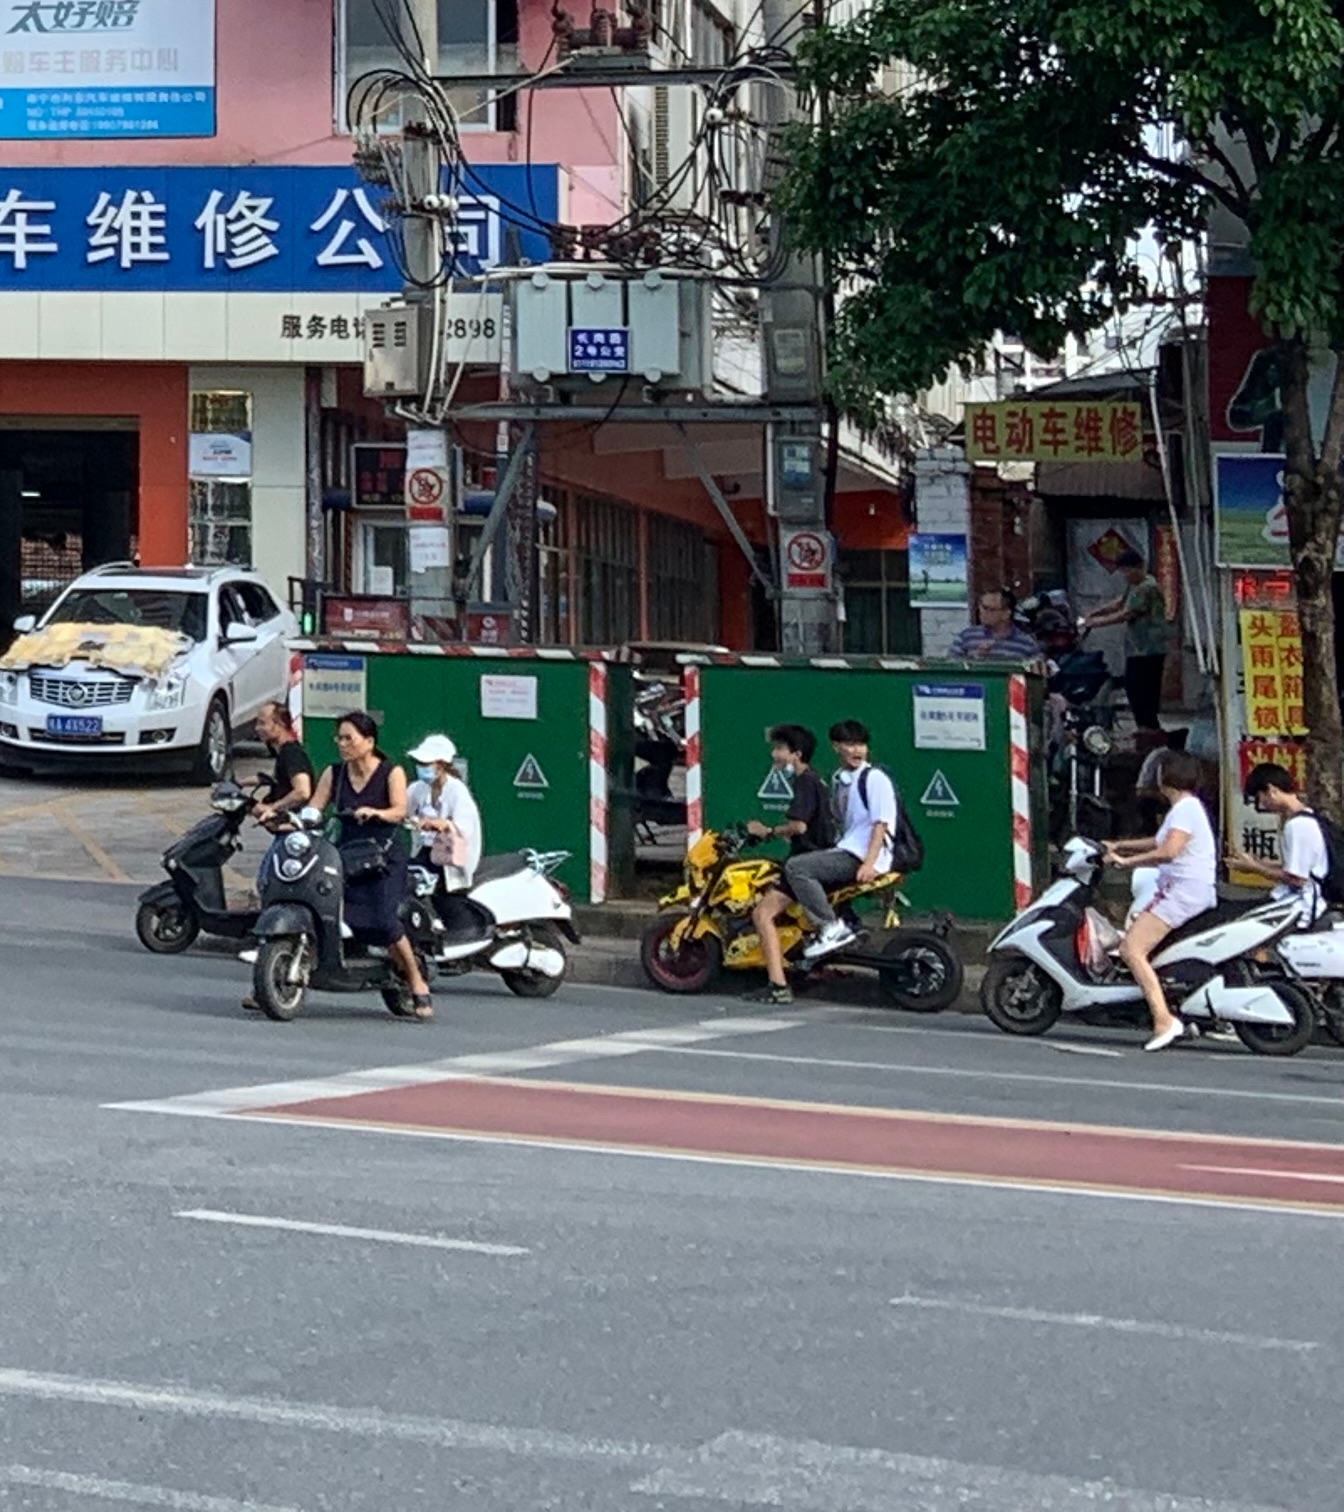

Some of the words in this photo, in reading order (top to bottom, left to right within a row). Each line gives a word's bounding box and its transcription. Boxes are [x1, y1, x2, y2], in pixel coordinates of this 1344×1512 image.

[972, 407, 1140, 457] 电动车维修
